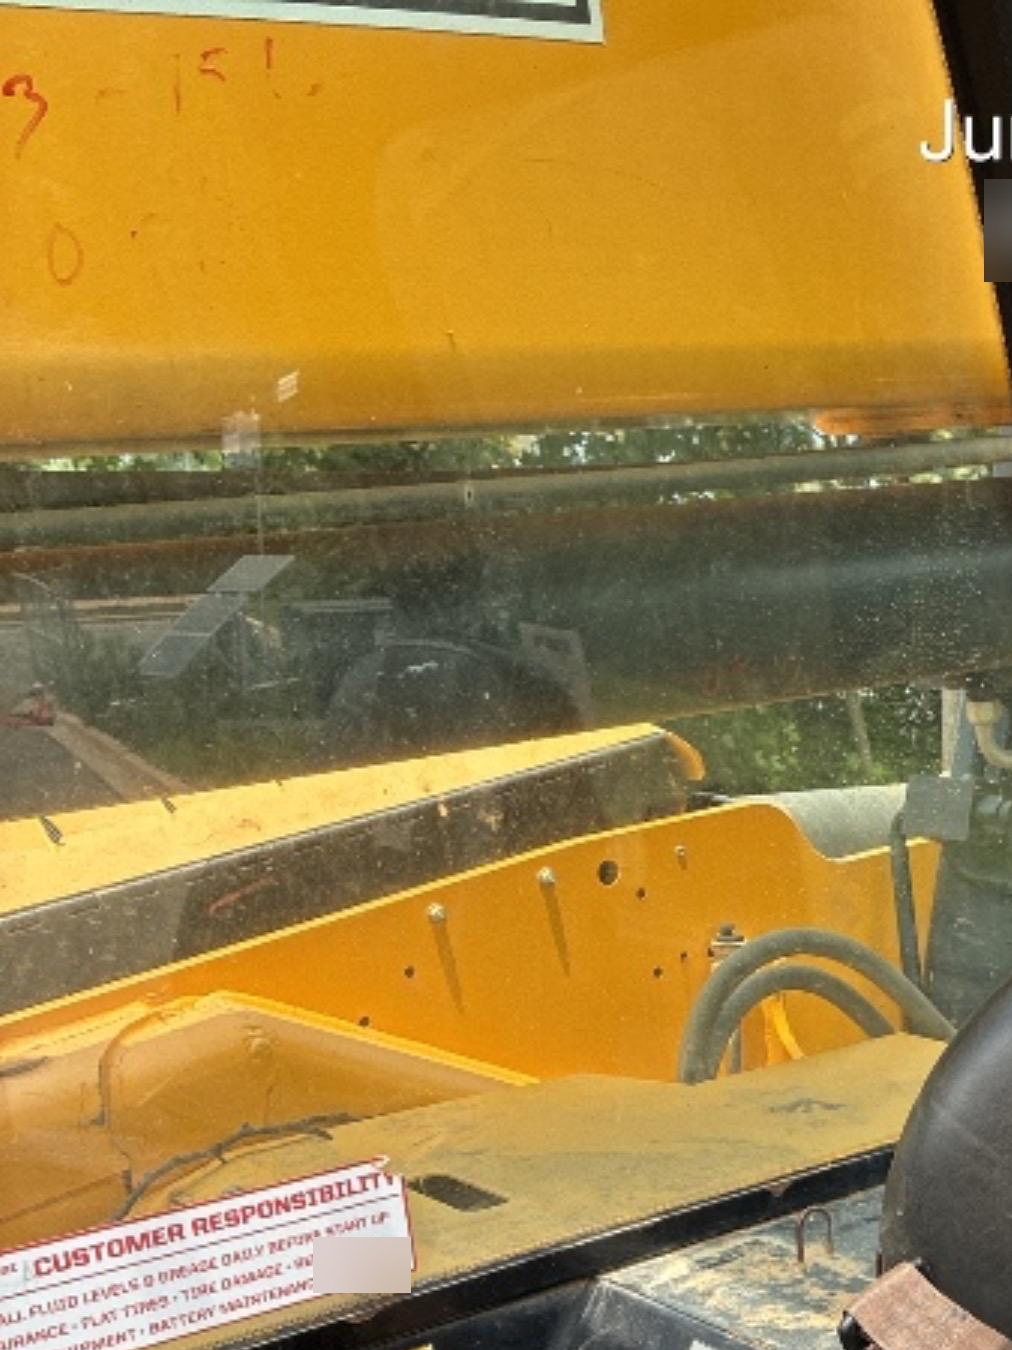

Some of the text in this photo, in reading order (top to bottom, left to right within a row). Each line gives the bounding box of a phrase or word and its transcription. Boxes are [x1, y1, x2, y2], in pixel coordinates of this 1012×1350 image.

[34, 1171, 394, 1277] CUSTOMER RESPONSIBILITY
[82, 1277, 141, 1305] LEVELS
